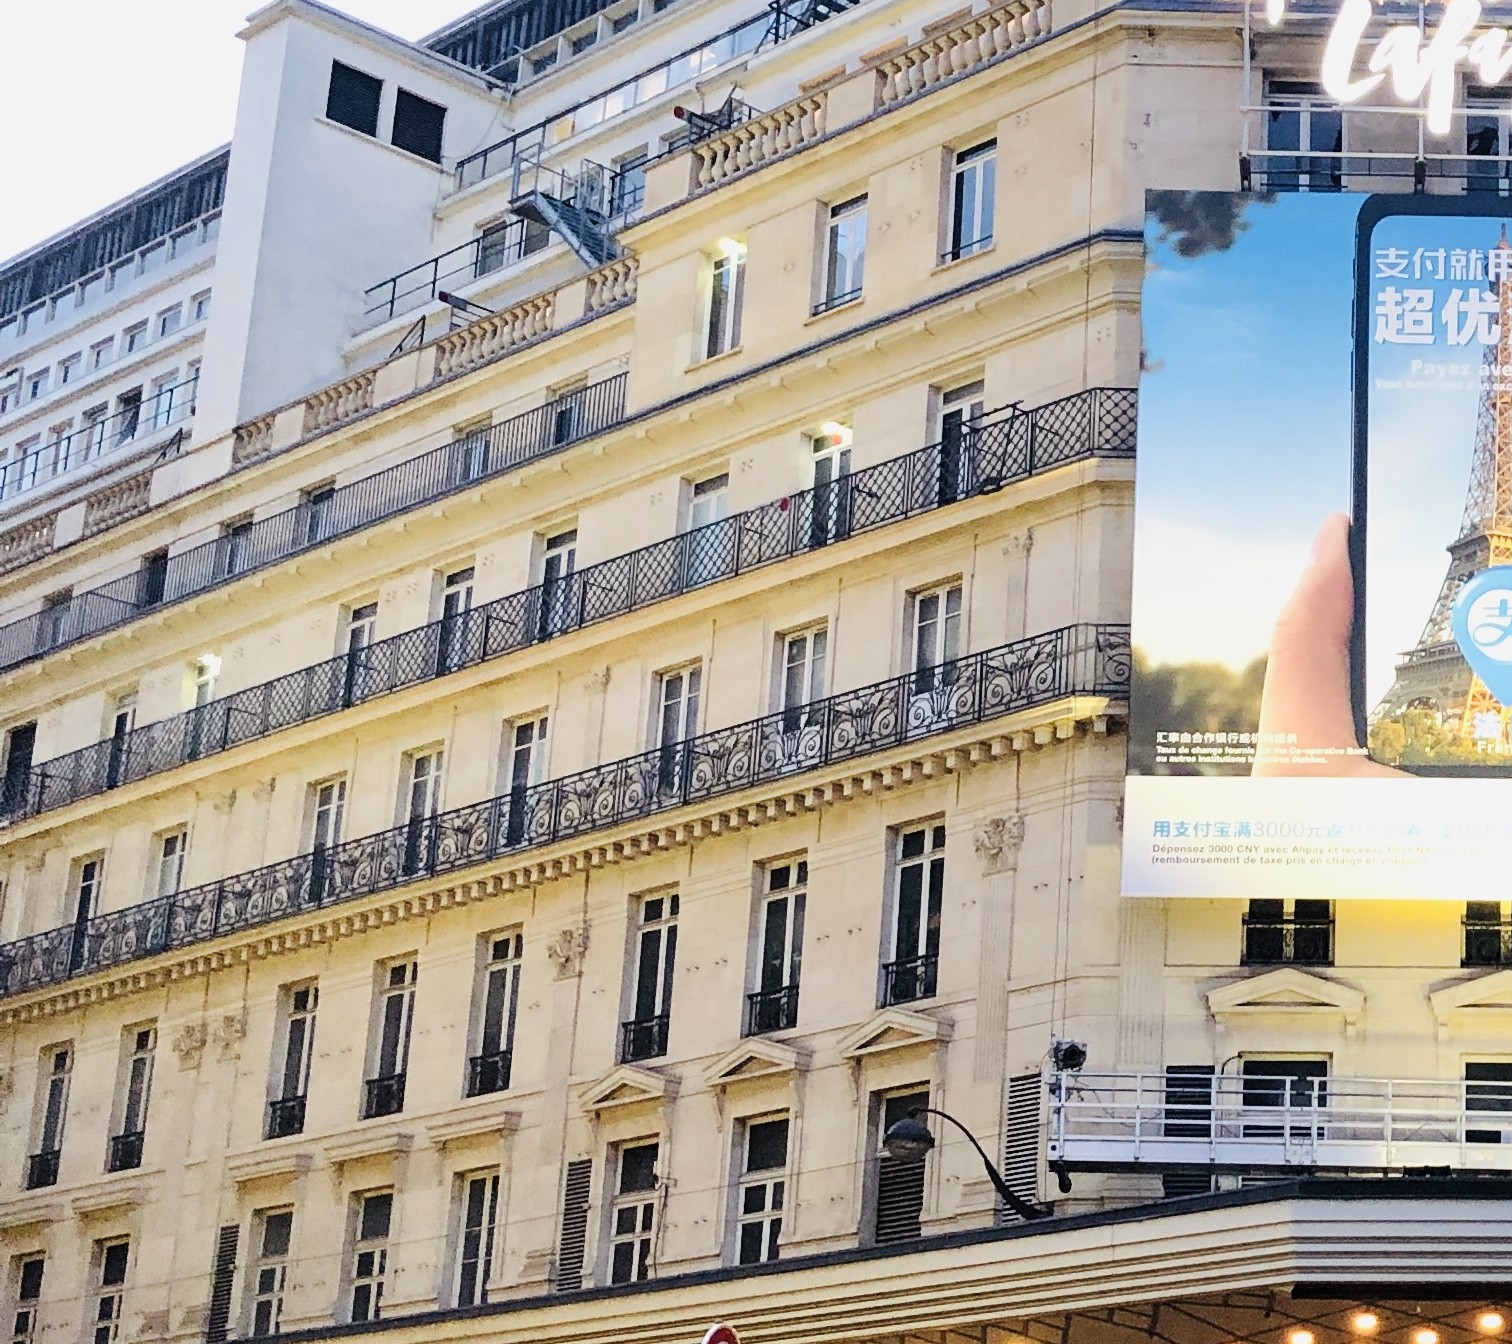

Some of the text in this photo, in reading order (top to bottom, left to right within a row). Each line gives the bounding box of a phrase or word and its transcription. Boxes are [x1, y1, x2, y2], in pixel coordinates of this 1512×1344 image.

[1411, 359, 1471, 377] Payez
[1178, 745, 1190, 755] de
[1191, 746, 1224, 757] change
[1152, 843, 1205, 855] Dépensez
[1208, 845, 1233, 853] 3000
[1236, 845, 1259, 853] CNY
[1263, 846, 1287, 854] avec
[1291, 845, 1325, 855] Alipay
[1151, 855, 1240, 865] (remboursement
[1243, 855, 1256, 864] de
[1259, 856, 1282, 864] taxe
[1285, 856, 1306, 866] pris
[1325, 856, 1362, 866] charge
